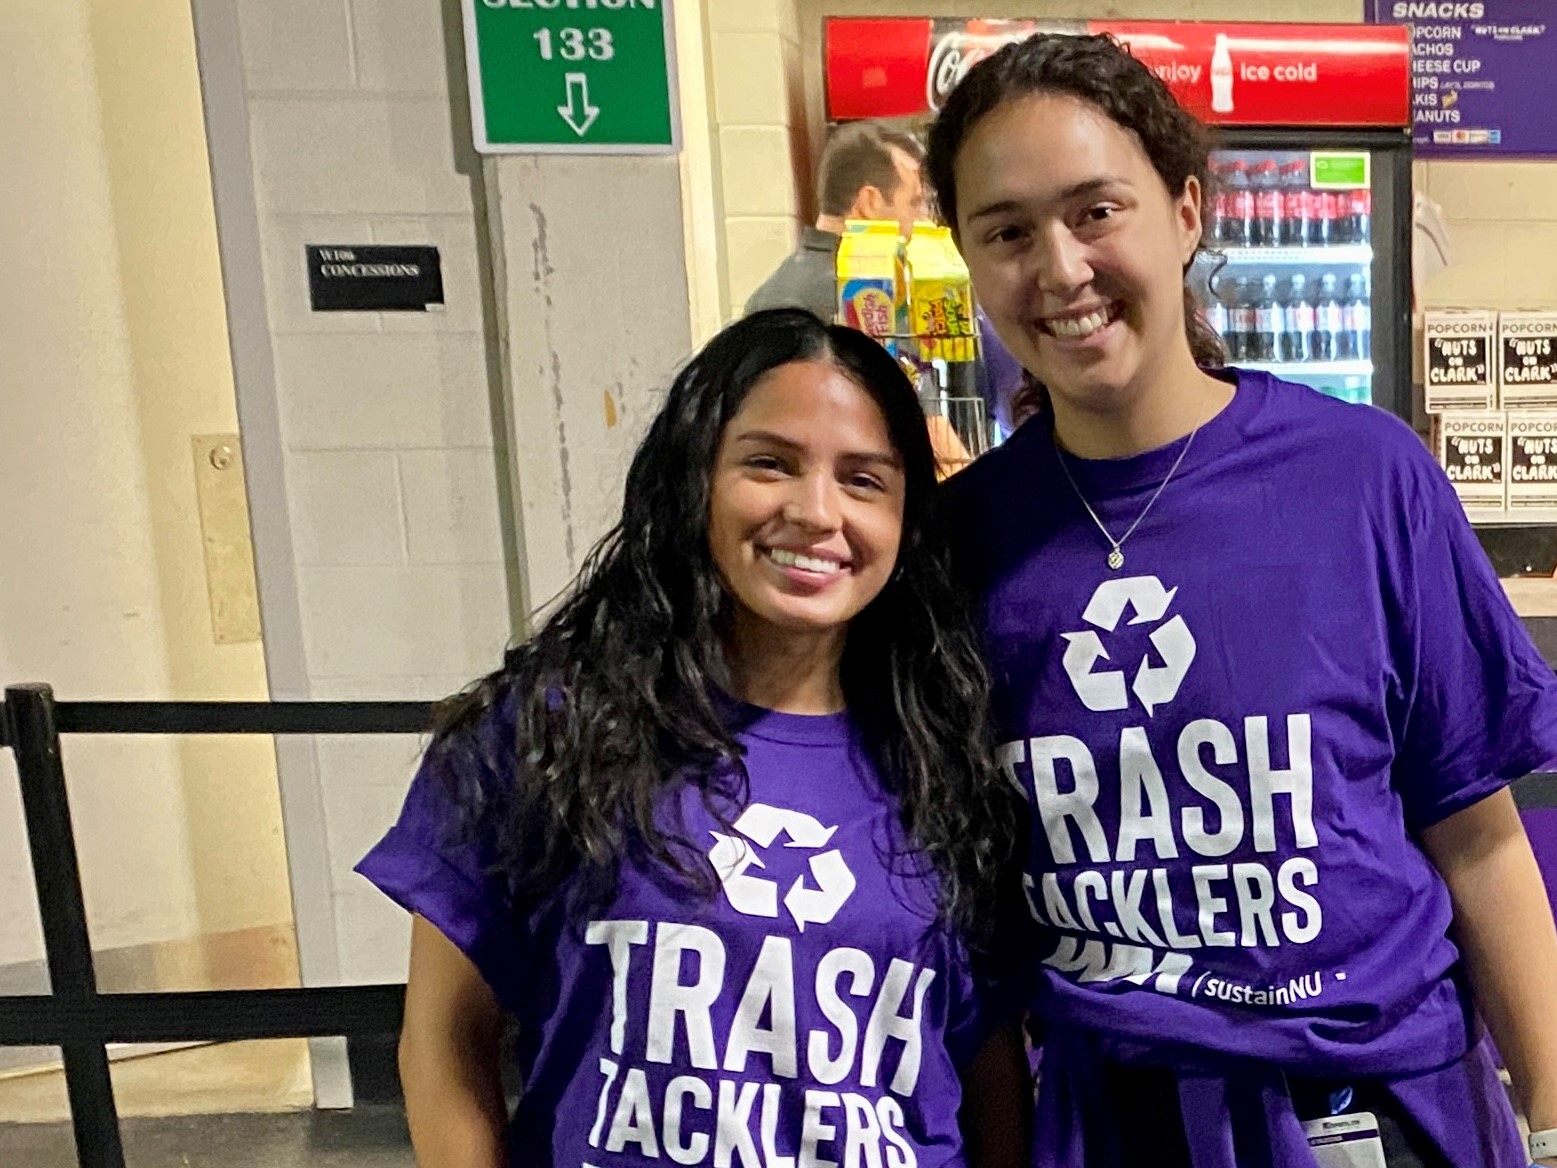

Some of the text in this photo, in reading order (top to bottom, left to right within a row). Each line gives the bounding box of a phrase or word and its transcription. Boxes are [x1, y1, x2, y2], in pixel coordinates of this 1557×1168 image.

[1393, 2, 1484, 18] SNACKS
[1412, 26, 1462, 39] PCORN
[533, 27, 615, 61] 133
[1412, 43, 1454, 56] CHOS
[1151, 59, 1202, 84] njoy
[1240, 61, 1318, 82] ice cold
[1412, 60, 1451, 73] EESE
[1453, 59, 1481, 73] CUP
[1412, 76, 1438, 89] IPS
[1412, 94, 1437, 107] KIS
[1413, 110, 1460, 123] ANUTS
[321, 263, 420, 278] CONCESSIONS
[1427, 323, 1487, 334] POPCORN
[1444, 422, 1504, 432] POPCORN
[1204, 971, 1323, 1006] sustainNU
[585, 920, 937, 1098] TRASH
